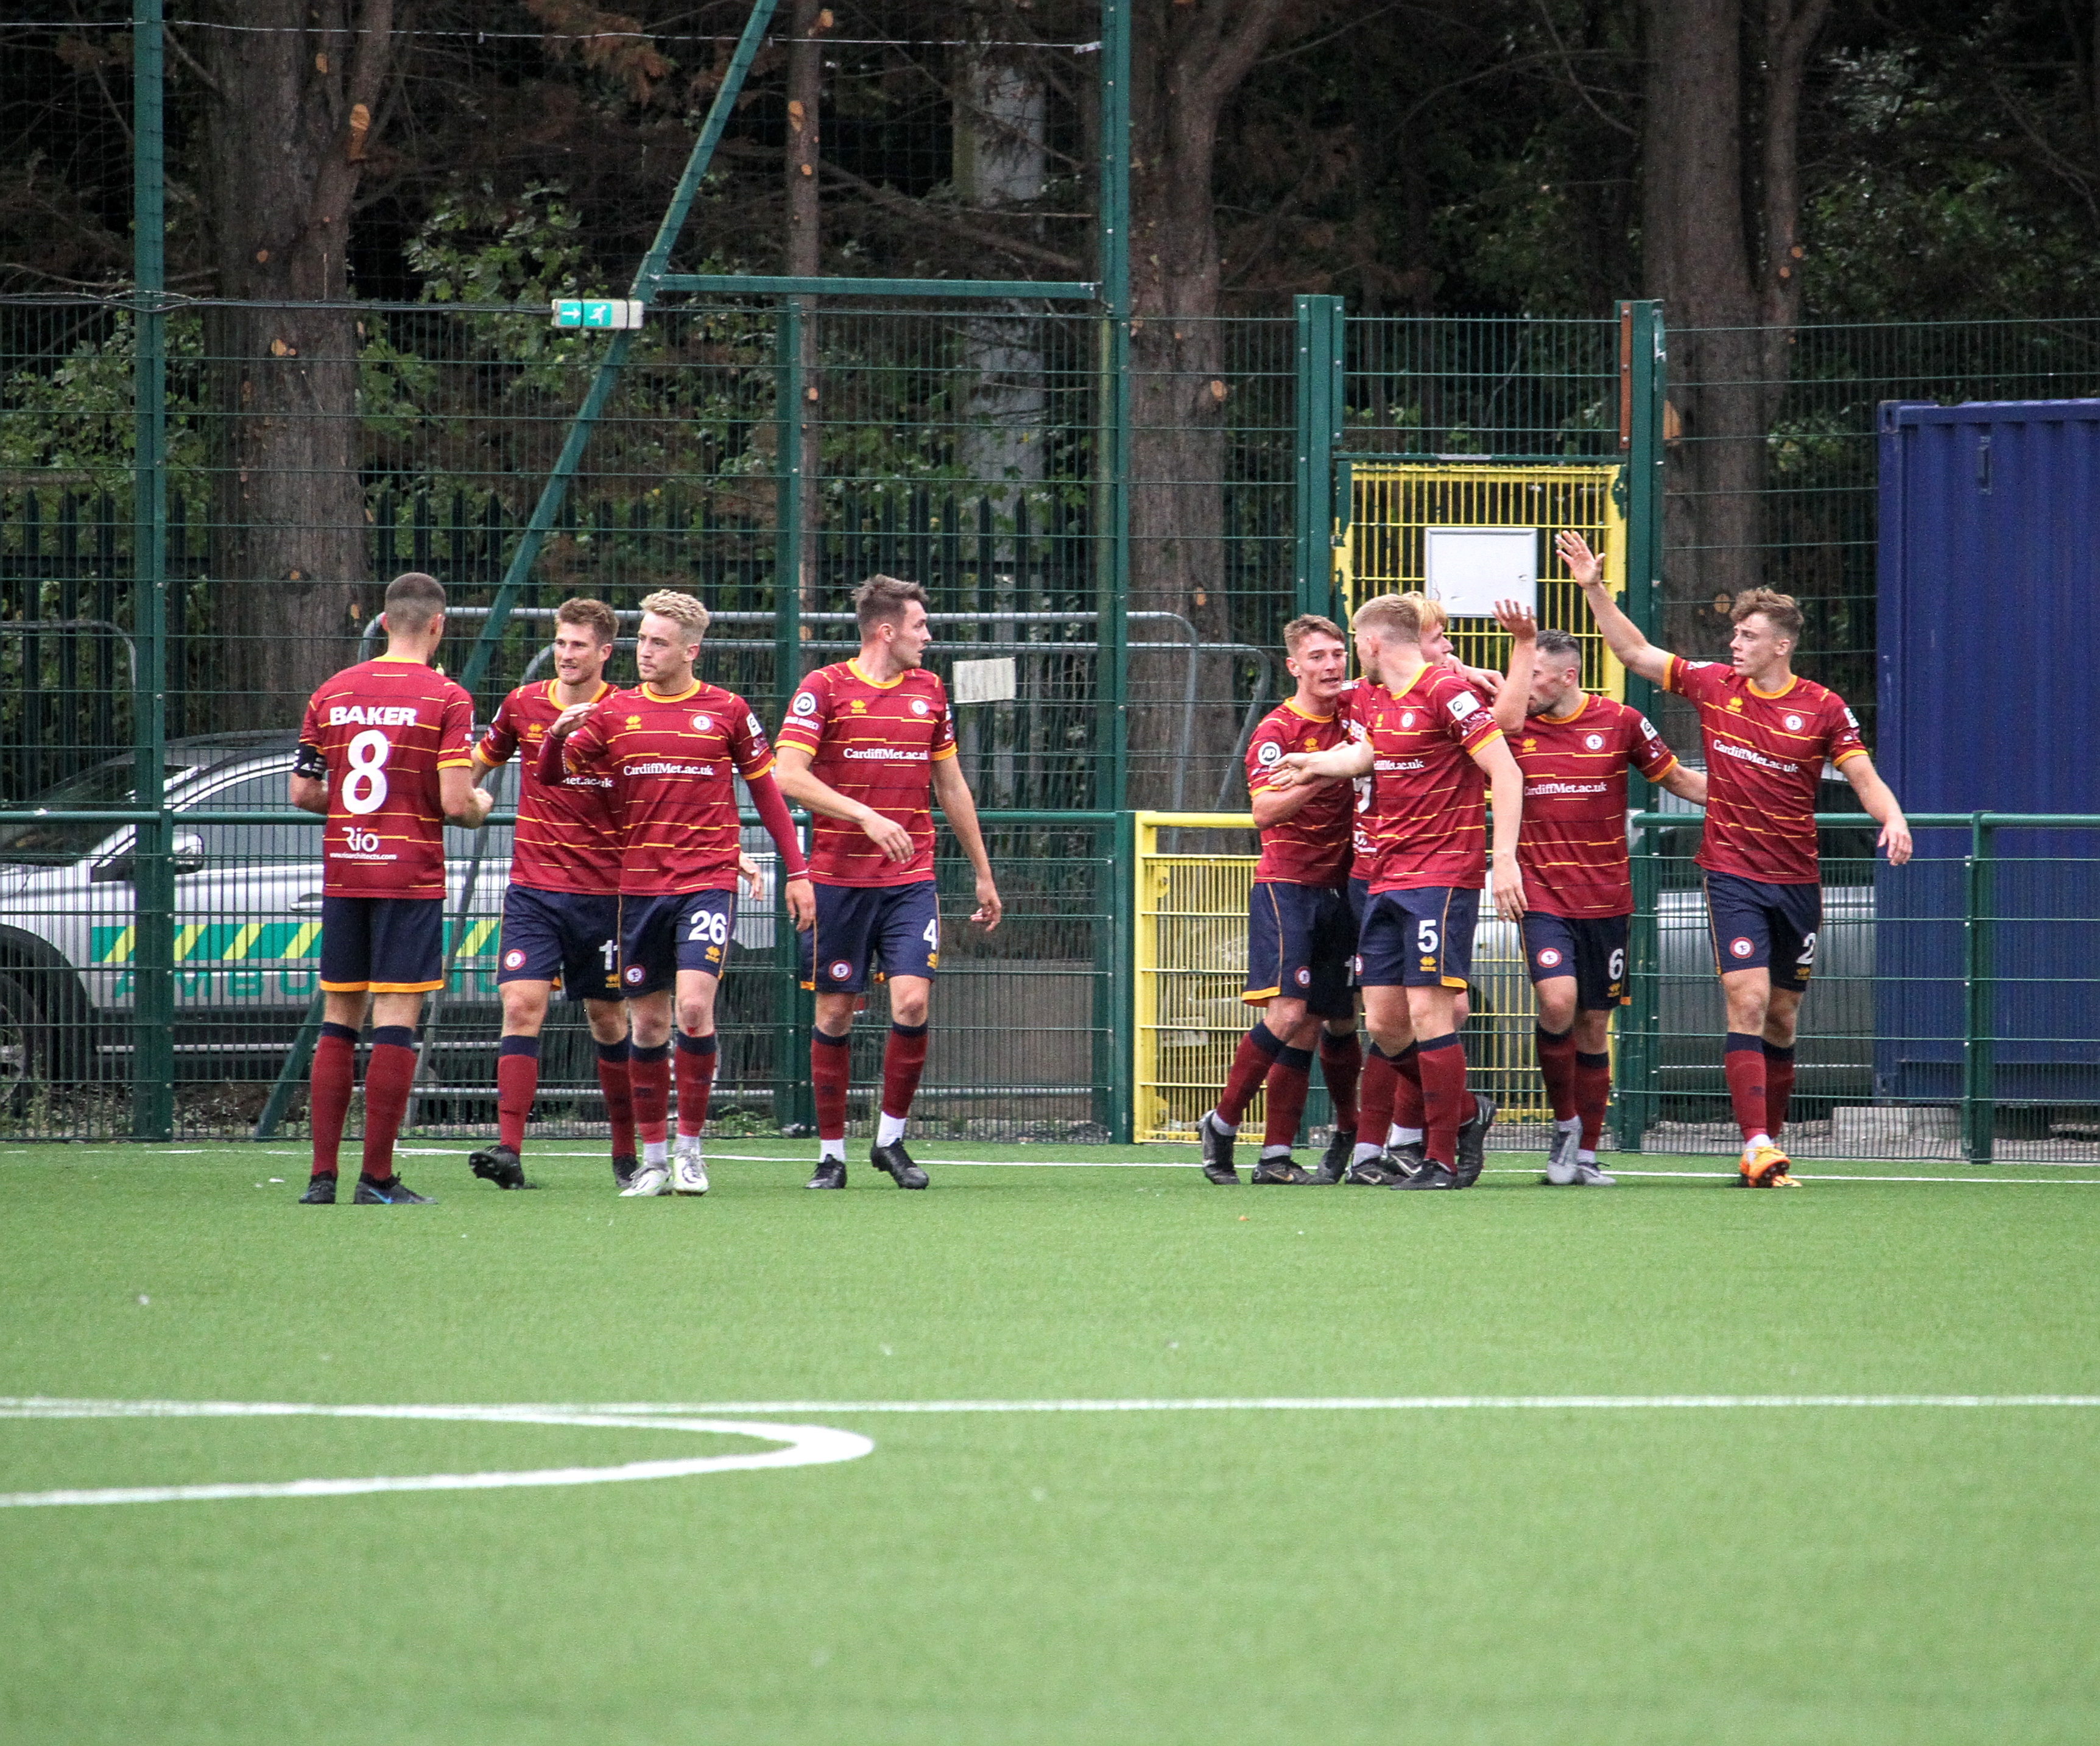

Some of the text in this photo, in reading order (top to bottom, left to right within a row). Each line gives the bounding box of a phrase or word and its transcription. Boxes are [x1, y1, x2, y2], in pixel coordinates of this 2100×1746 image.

[329, 705, 417, 727] BAKER
[342, 729, 390, 815] 8
[623, 763, 714, 776] CardiffMet.ac.uk
[342, 827, 379, 852] Rio
[688, 910, 728, 945] 26
[923, 919, 937, 950] 4
[1418, 919, 1439, 953] 5
[1608, 948, 1624, 980] 6
[1795, 932, 1817, 965] 2
